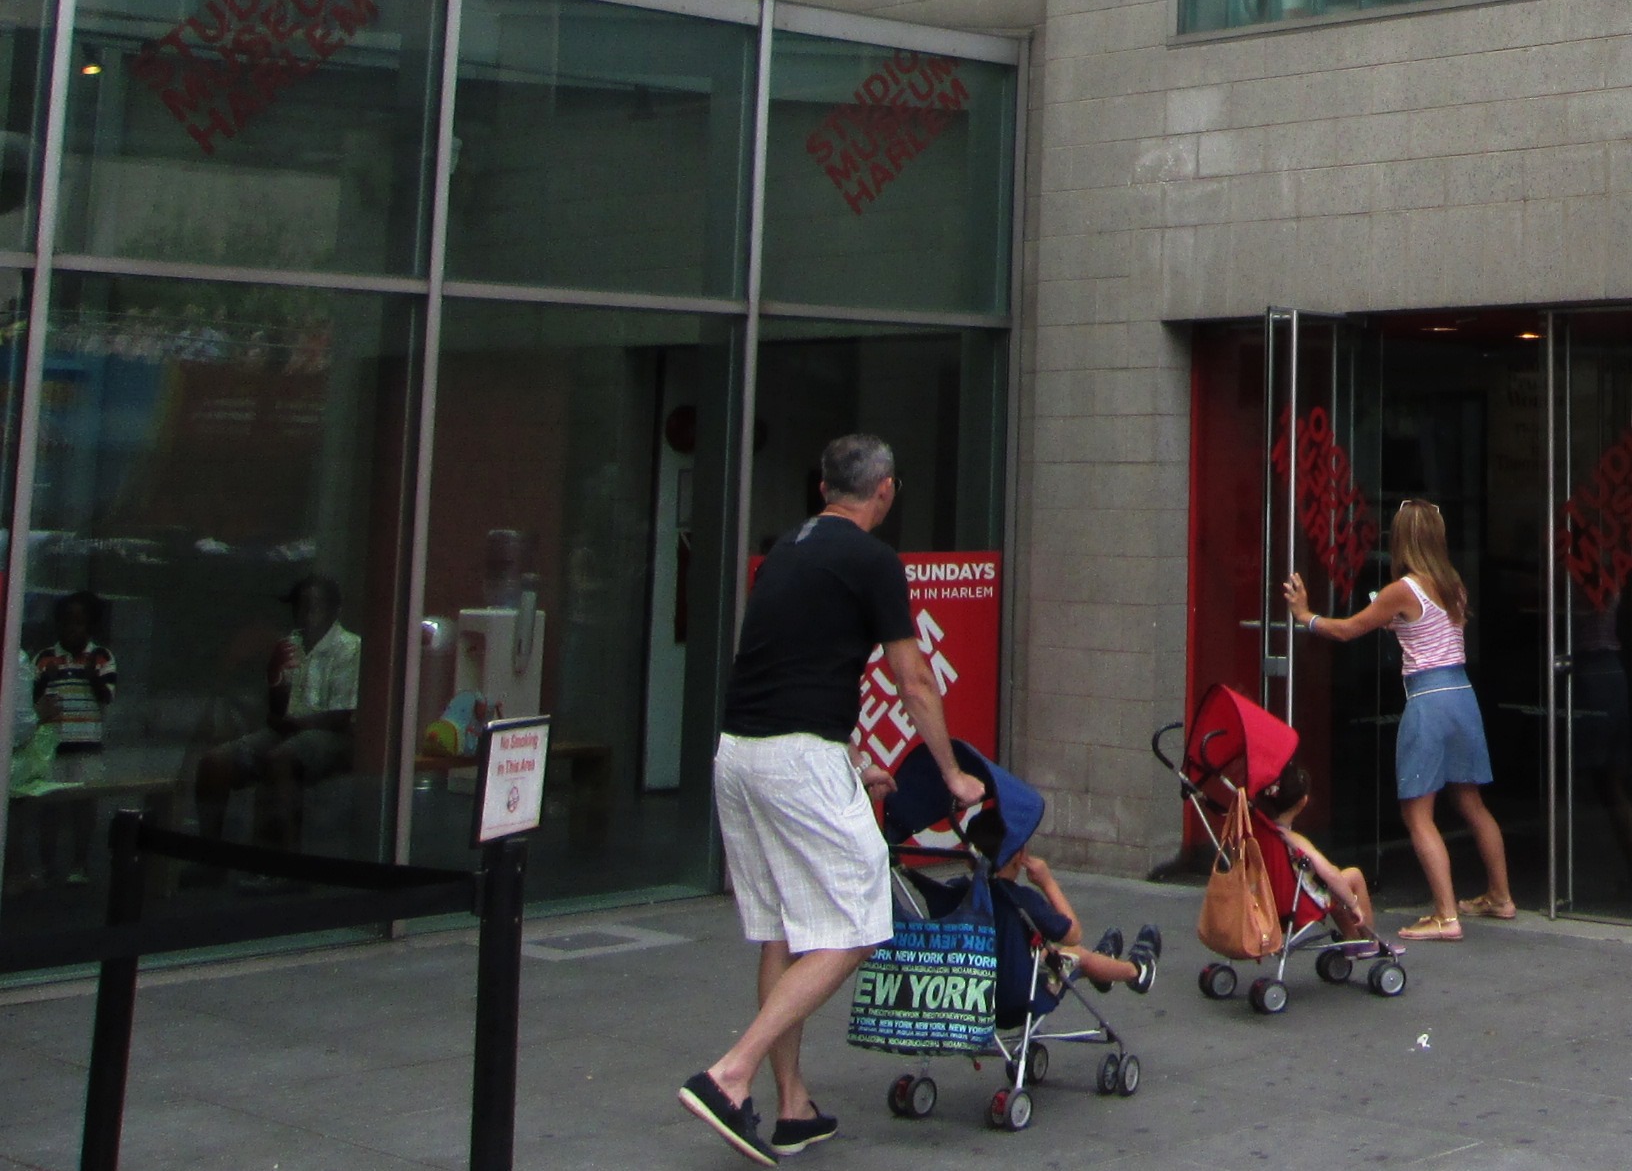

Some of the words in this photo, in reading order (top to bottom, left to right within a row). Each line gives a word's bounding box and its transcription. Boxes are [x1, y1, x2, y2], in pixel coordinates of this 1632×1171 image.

[806, 50, 919, 164] STUDIO
[826, 57, 961, 190] MUSEUM
[843, 78, 970, 215] HARLEM
[905, 563, 995, 582] SUNDAYS
[924, 588, 937, 599] IN
[941, 586, 993, 598] HARLEM
[500, 736, 510, 750] No
[511, 733, 539, 750] Smoking
[895, 950, 916, 963] NEW
[918, 951, 943, 965] YORK
[909, 975, 992, 1014] YORK
